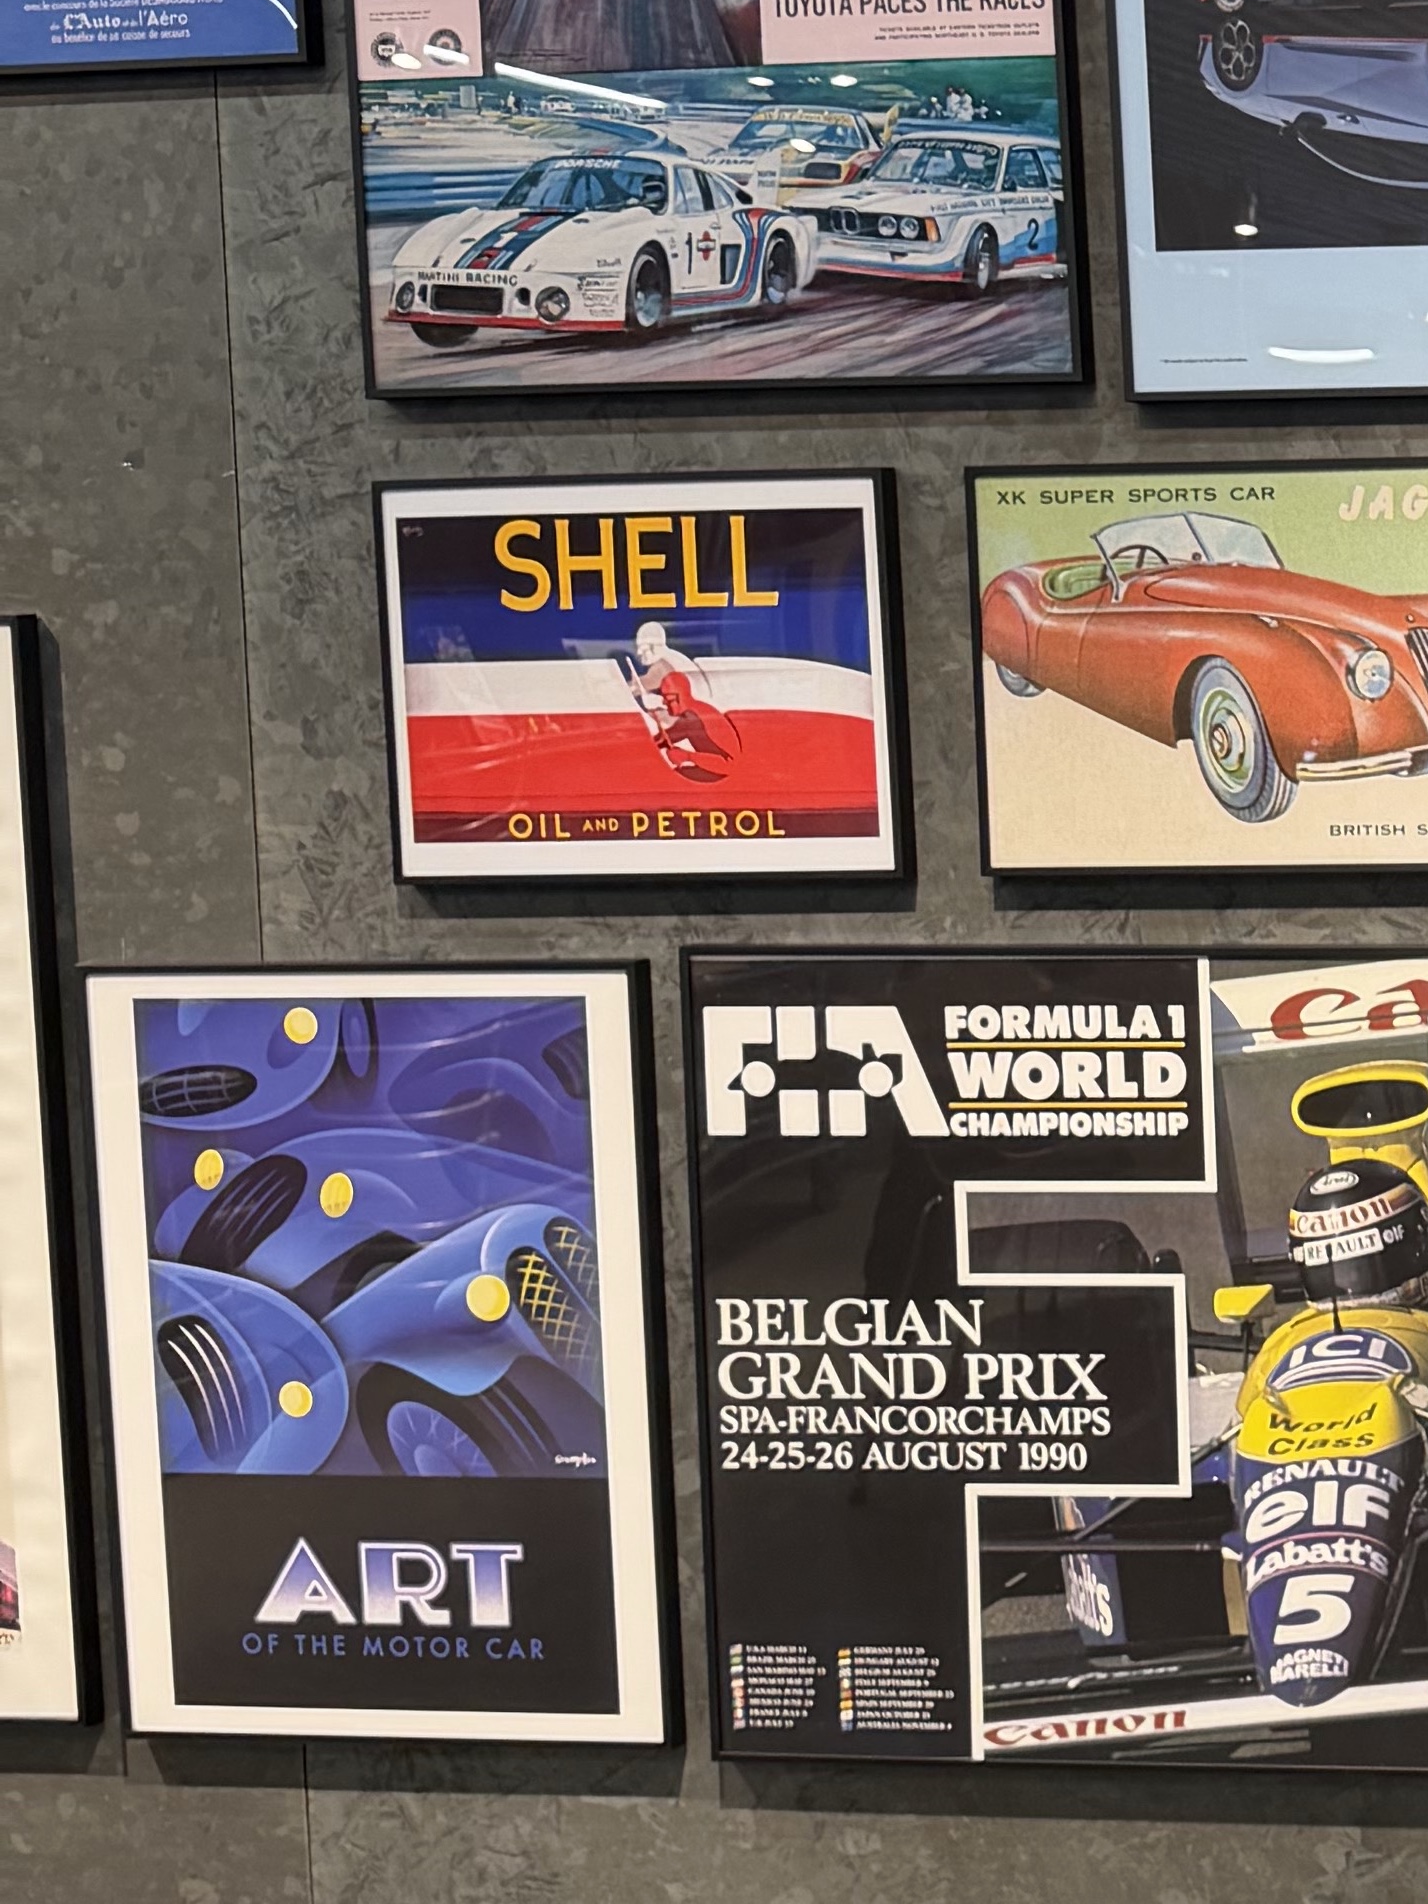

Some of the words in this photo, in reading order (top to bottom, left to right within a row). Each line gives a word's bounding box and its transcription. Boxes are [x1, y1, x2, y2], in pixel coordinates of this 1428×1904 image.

[554, 158, 623, 170] PORSCHE
[417, 270, 460, 284] MARTINI
[465, 271, 519, 287] RACING
[996, 490, 1026, 505] XK
[1040, 489, 1115, 504] SUPER
[1127, 487, 1217, 503] SPORTS
[1229, 486, 1276, 501] CAR
[493, 515, 779, 613] SHELL
[508, 813, 571, 840] OIL
[582, 818, 620, 833] AND
[632, 810, 786, 838] PETROL
[1329, 822, 1407, 838] BRITISH
[948, 1051, 1189, 1101] WORLD
[949, 1110, 1190, 1139] CHAMPIONSHIP
[715, 1297, 984, 1348] BELGIAN
[1288, 1335, 1386, 1369] ICI
[717, 1352, 948, 1402] GRAND
[963, 1352, 1109, 1402] PRIX
[720, 1405, 1112, 1438] SPA-FRANCORCHAMPS
[1267, 1402, 1378, 1433] World
[721, 1441, 854, 1472] 24-25-26
[863, 1441, 1010, 1472] AUGUST
[1019, 1441, 1089, 1472] 1990
[1267, 1431, 1375, 1456] Class
[1244, 1458, 1405, 1508] RENAULT
[1246, 1480, 1391, 1543] elf
[1246, 1539, 1389, 1590] Labatt's
[254, 1536, 524, 1627] ART
[1273, 1573, 1356, 1646] 5
[242, 1633, 280, 1655] OF
[294, 1634, 346, 1656] THE
[362, 1635, 470, 1659] MOTOR
[486, 1637, 545, 1660] CAR
